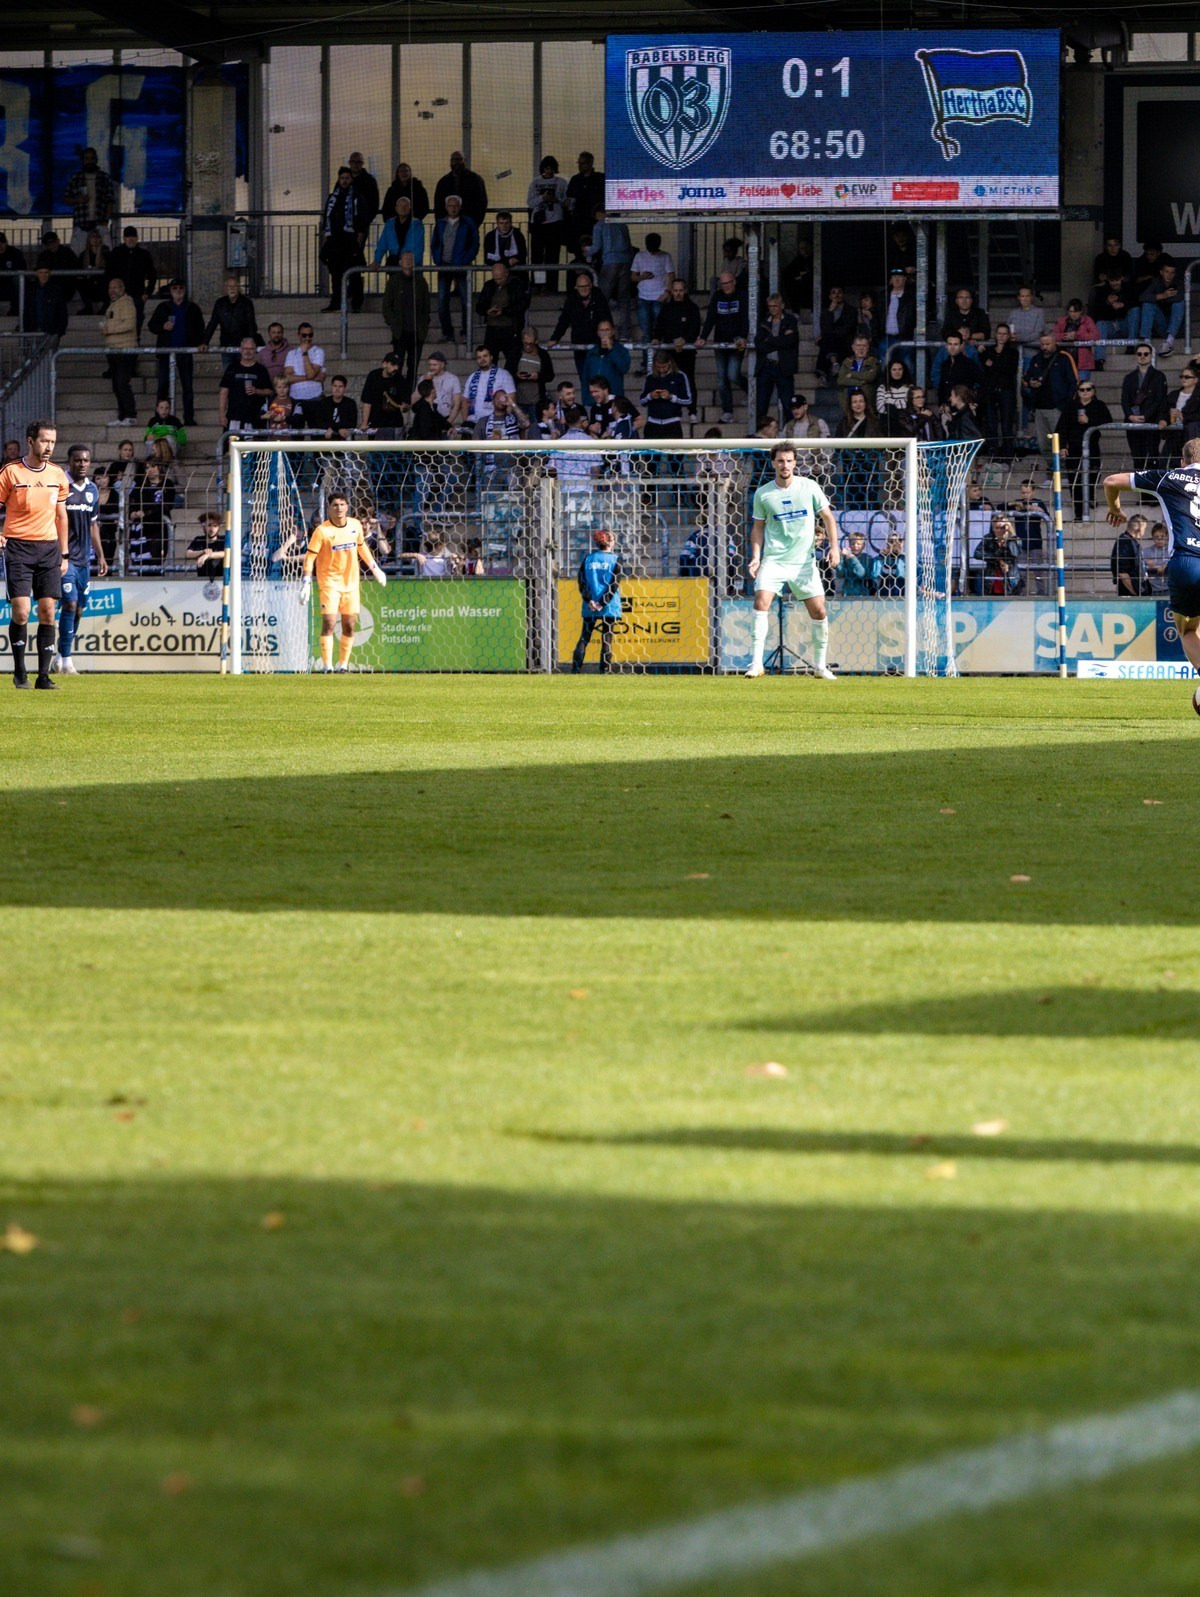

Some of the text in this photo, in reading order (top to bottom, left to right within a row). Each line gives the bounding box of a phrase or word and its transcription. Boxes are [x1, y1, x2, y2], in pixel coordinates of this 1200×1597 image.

[632, 50, 725, 64] BABELSBERG
[781, 57, 850, 98] 0:1
[769, 129, 865, 160] 68:50
[739, 185, 822, 198] Potsdam Liebe
[851, 184, 877, 195] EWP
[130, 612, 161, 626] Job
[380, 606, 501, 620] Energie und Wasser
[381, 623, 432, 632] Stadtwerke
[381, 634, 421, 643] Potsdam
[1034, 612, 1136, 659] SAP
